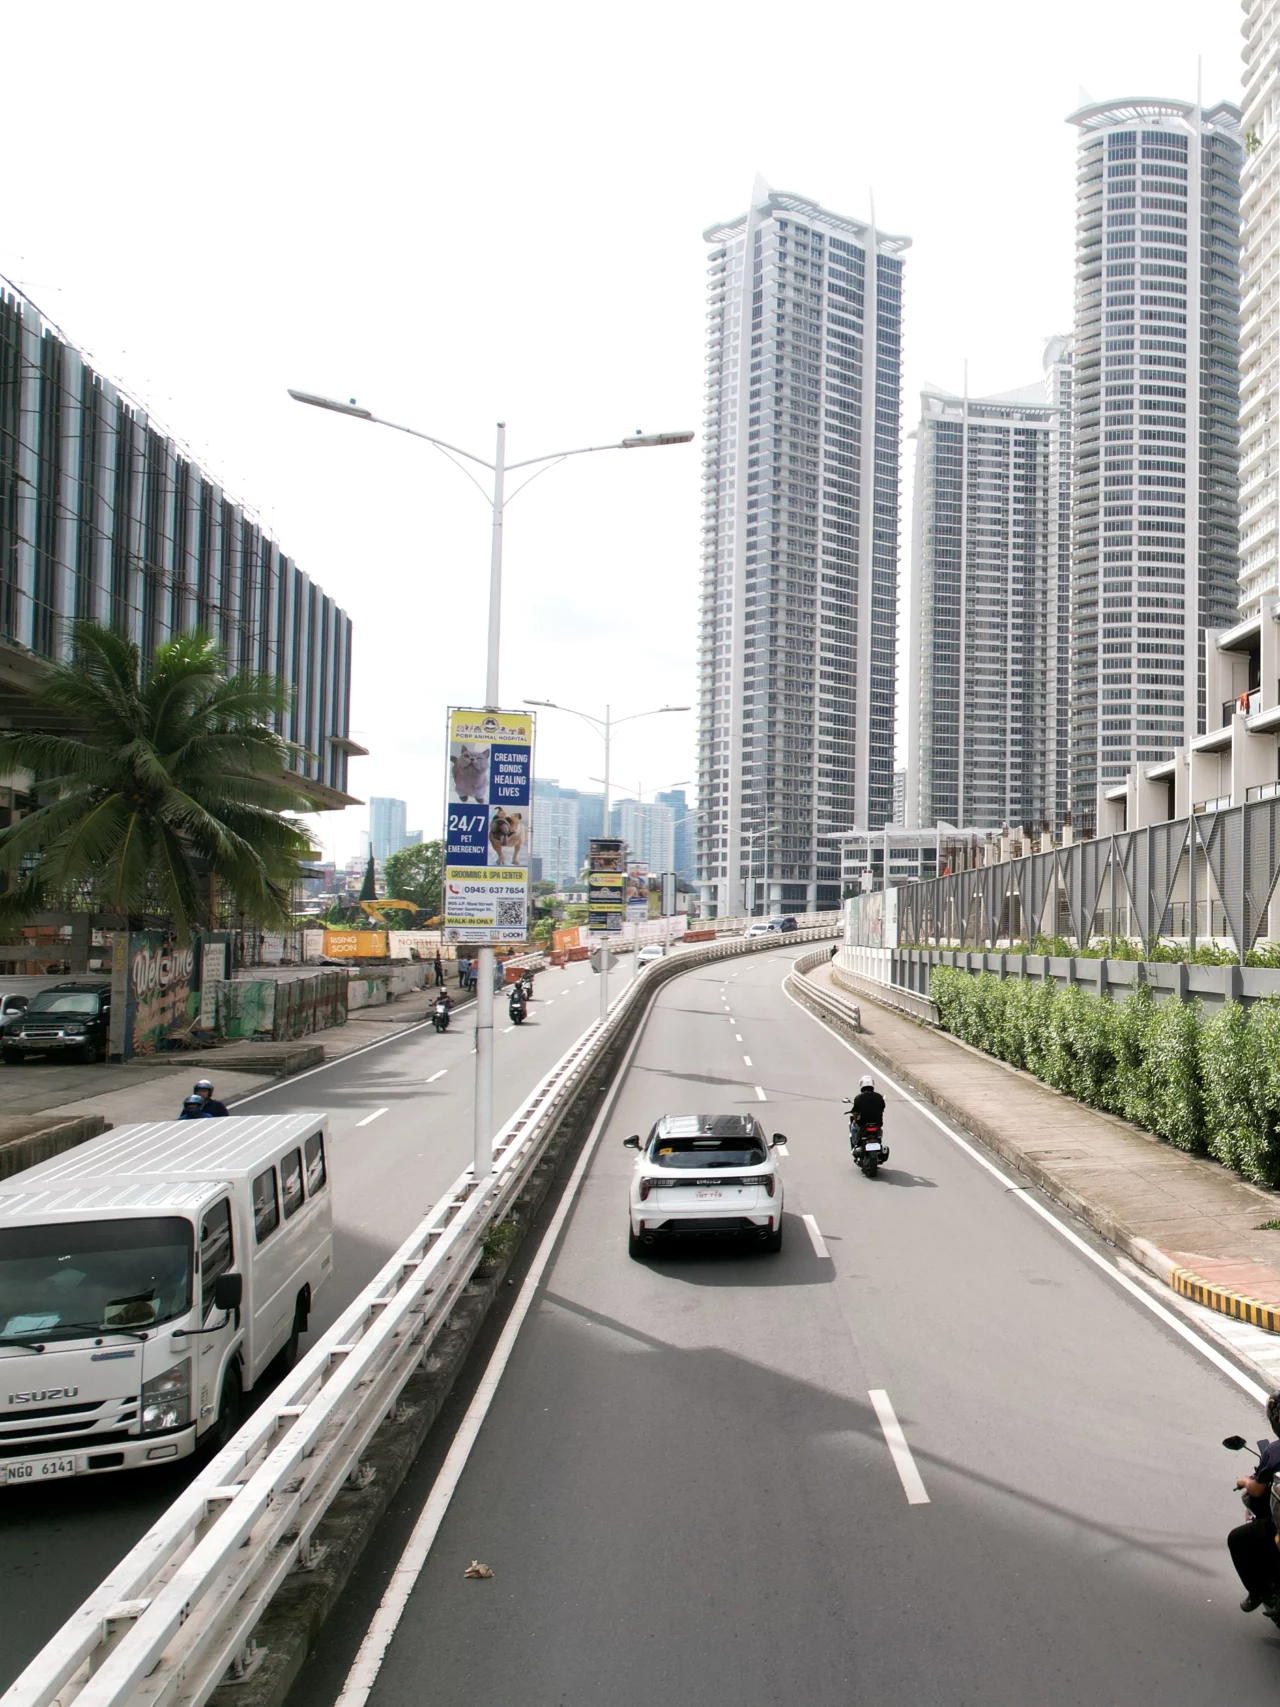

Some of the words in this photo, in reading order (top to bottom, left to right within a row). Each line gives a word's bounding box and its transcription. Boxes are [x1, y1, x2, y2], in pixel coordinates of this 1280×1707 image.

[494, 752, 528, 763] CREATING
[499, 764, 522, 773] BONDS
[494, 775, 527, 785] HEALING
[498, 786, 520, 797] LIVES
[449, 814, 486, 832] 24/7
[460, 835, 472, 843] PET
[448, 845, 485, 853] EMERGENCY
[451, 870, 482, 879] GROOMING
[483, 871, 488, 879] &
[489, 871, 501, 879] SPA
[502, 871, 523, 880] CENTER
[464, 886, 486, 894] 0945
[489, 886, 504, 894] 637
[330, 936, 357, 944] RISING
[398, 938, 432, 946] NORTH
[331, 944, 357, 953] SOON
[8, 1385, 79, 1404] ISUZU
[8, 1465, 33, 1479] NGQ
[42, 1460, 74, 1475] 6141
